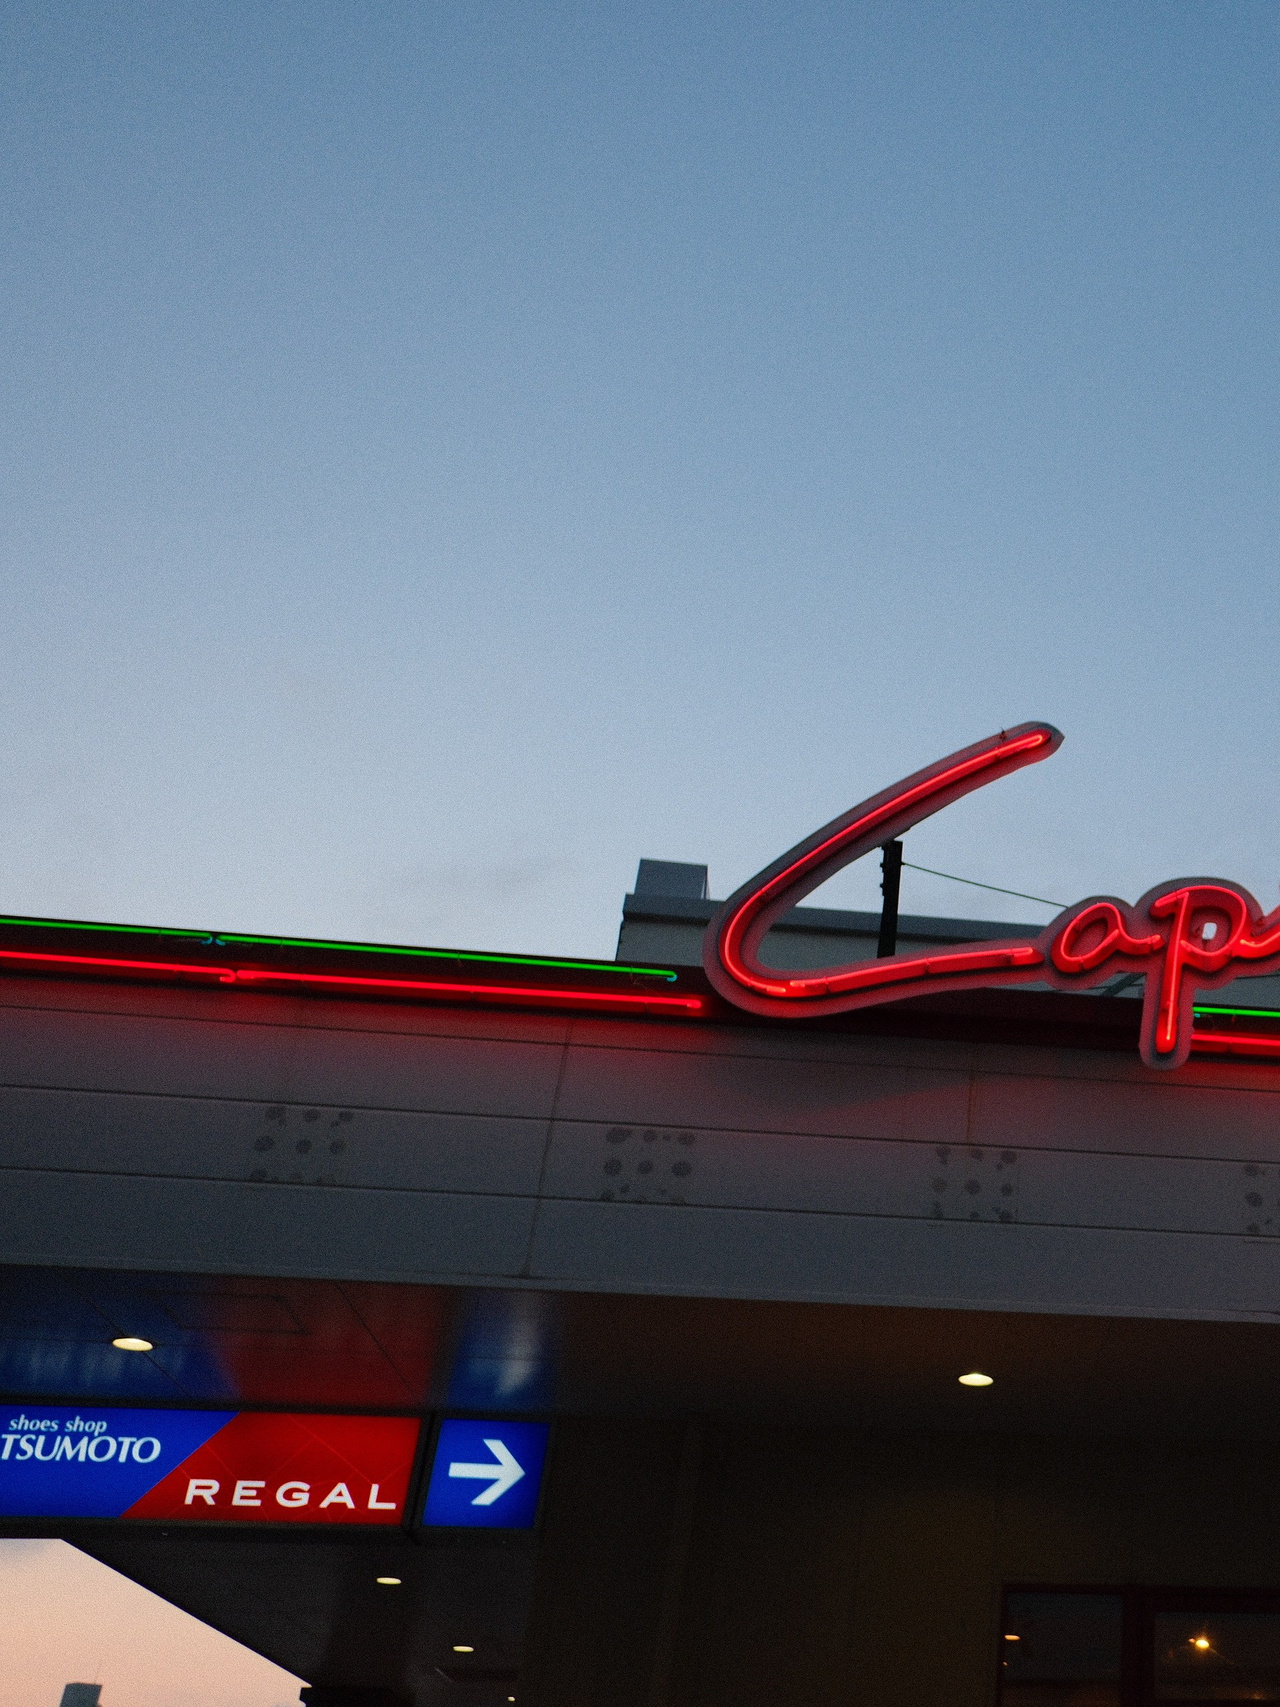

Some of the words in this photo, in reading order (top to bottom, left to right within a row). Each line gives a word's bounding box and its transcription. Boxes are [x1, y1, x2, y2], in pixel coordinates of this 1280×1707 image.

[8, 1414, 59, 1432] shoes
[64, 1415, 107, 1437] shop
[1, 1434, 161, 1463] TSUMOTO
[184, 1478, 397, 1510] REGAL
